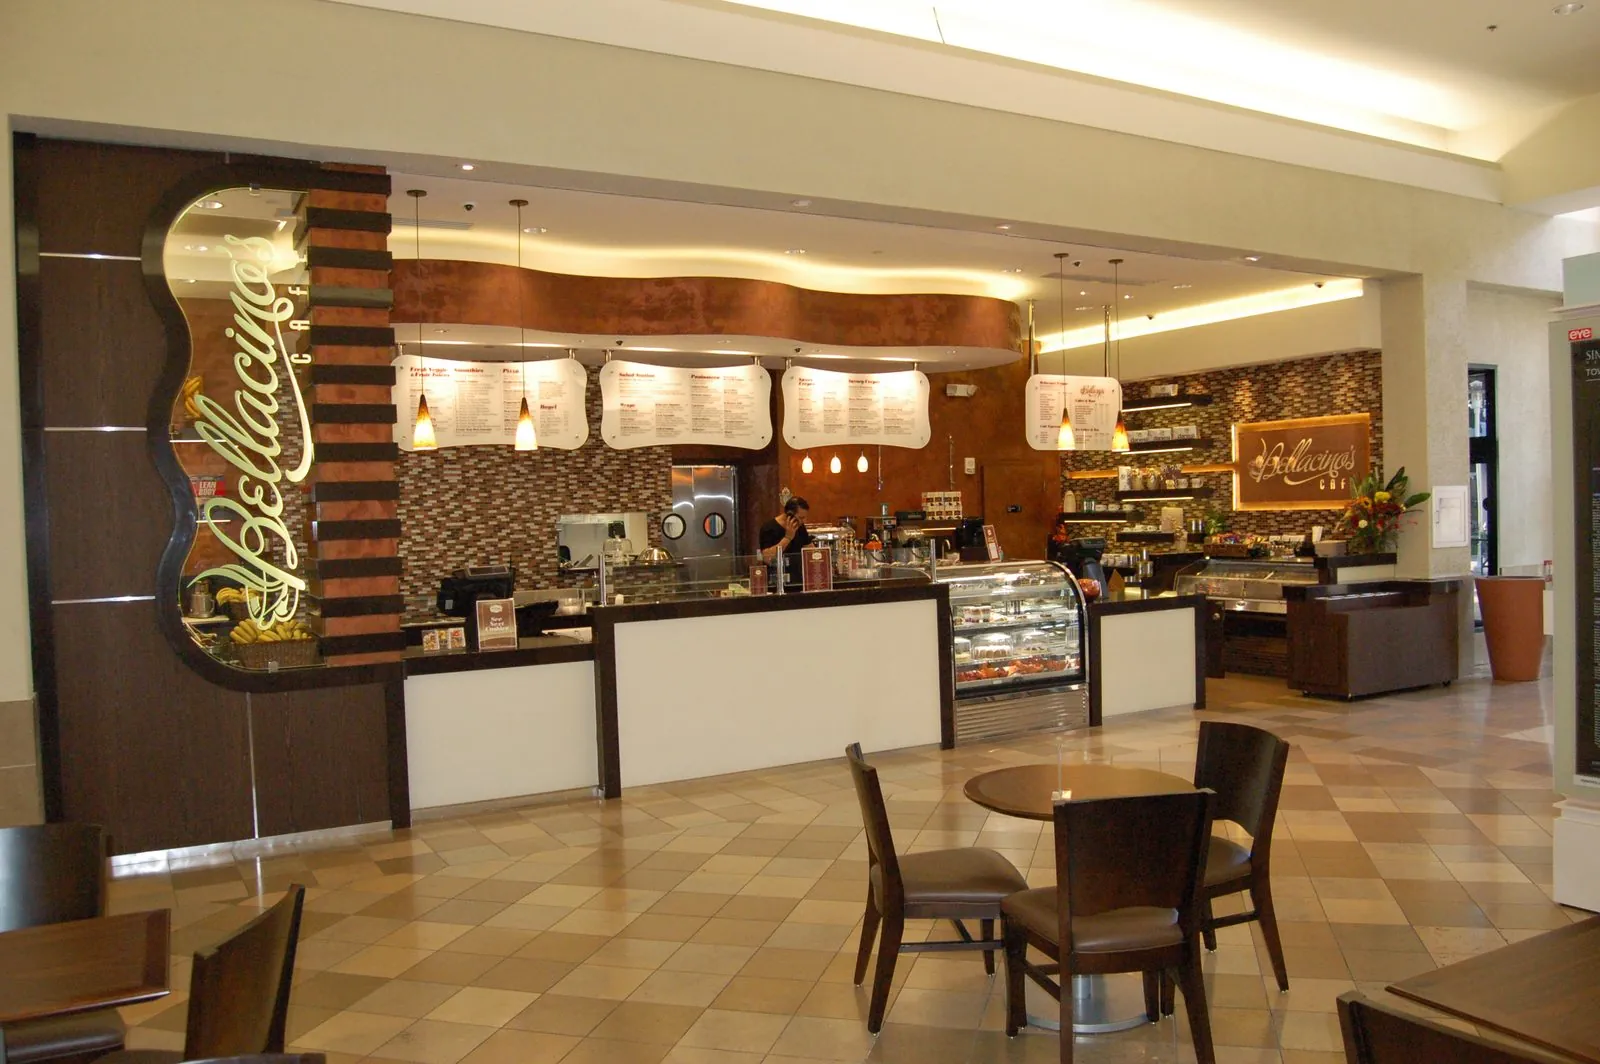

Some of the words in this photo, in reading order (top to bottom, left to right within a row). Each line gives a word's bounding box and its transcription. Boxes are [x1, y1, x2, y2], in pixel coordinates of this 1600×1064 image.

[194, 234, 308, 592] Bellacino's
[1256, 437, 1357, 484] Bellacino's
[1319, 477, 1347, 491] CAF
